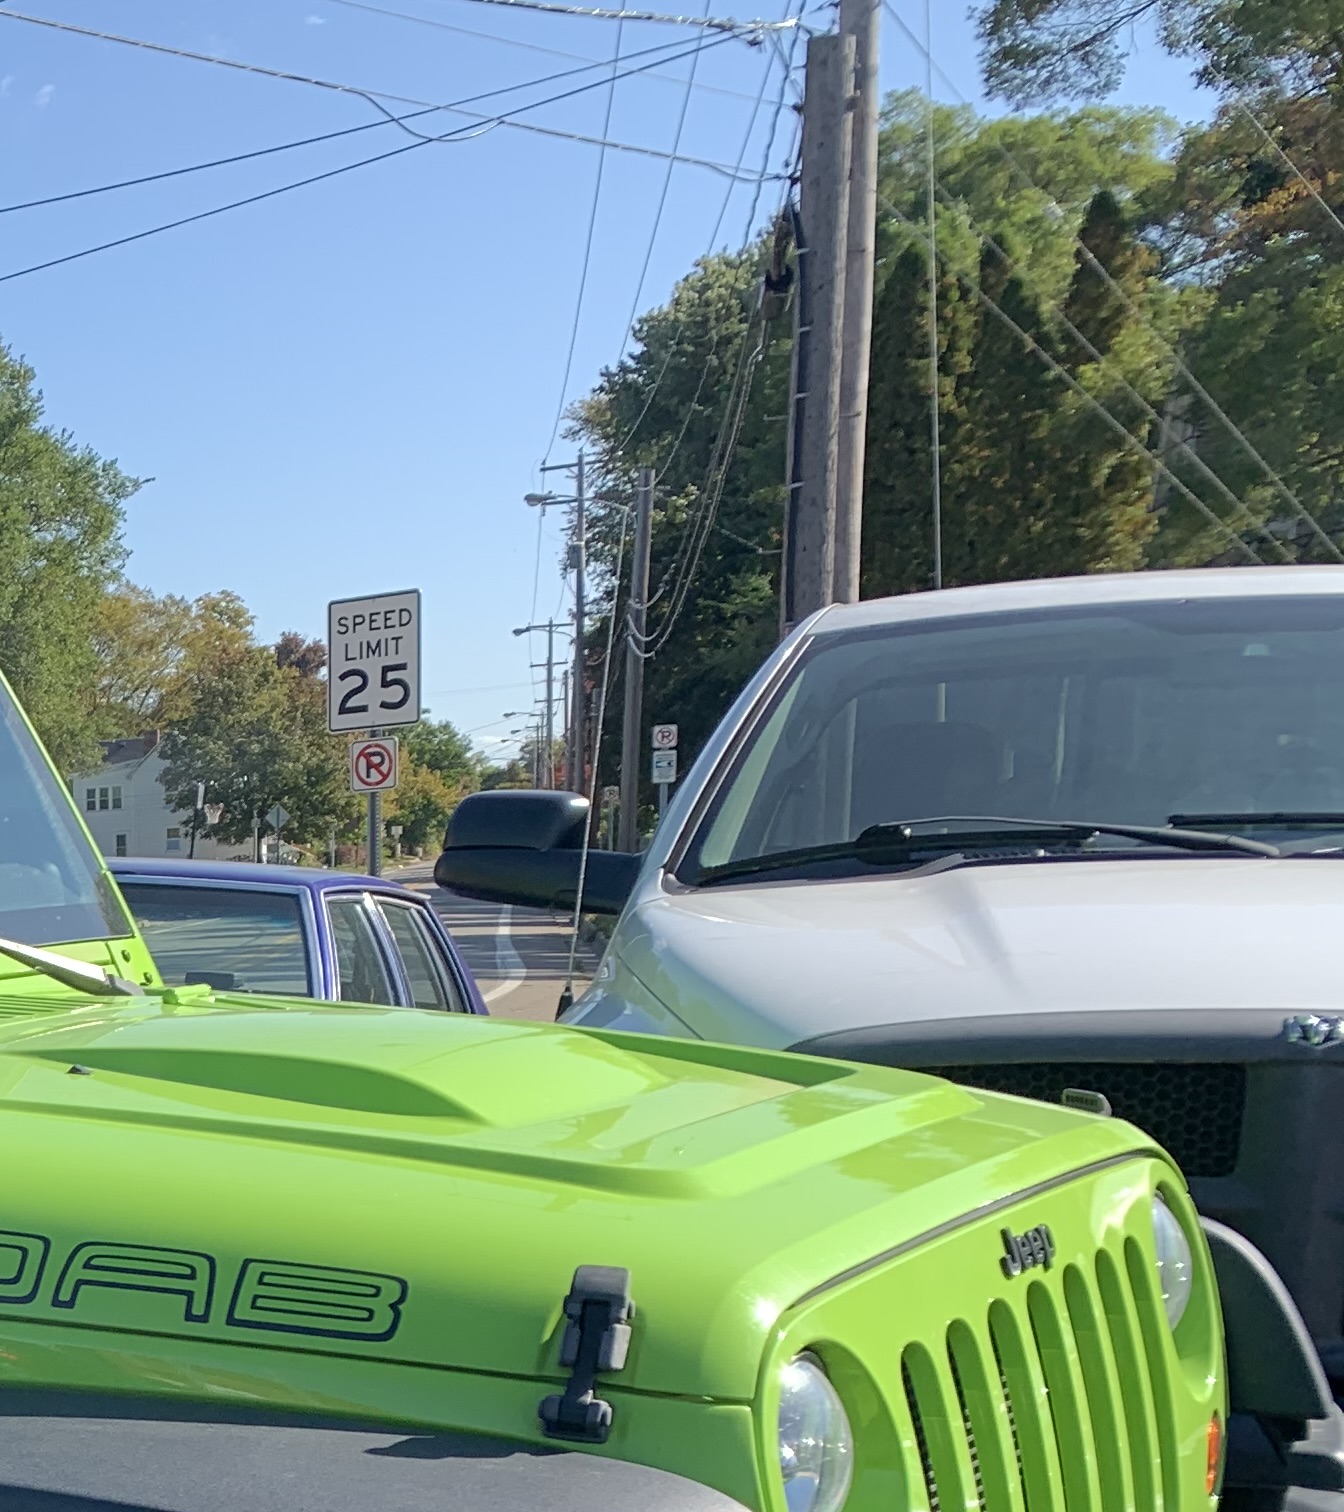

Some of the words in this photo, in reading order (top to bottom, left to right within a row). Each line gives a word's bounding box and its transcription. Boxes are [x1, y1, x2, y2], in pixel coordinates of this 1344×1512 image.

[337, 608, 412, 635] SPEED
[344, 636, 403, 662] LIMIT
[338, 662, 411, 715] 25
[999, 1223, 1056, 1280] Jeep
